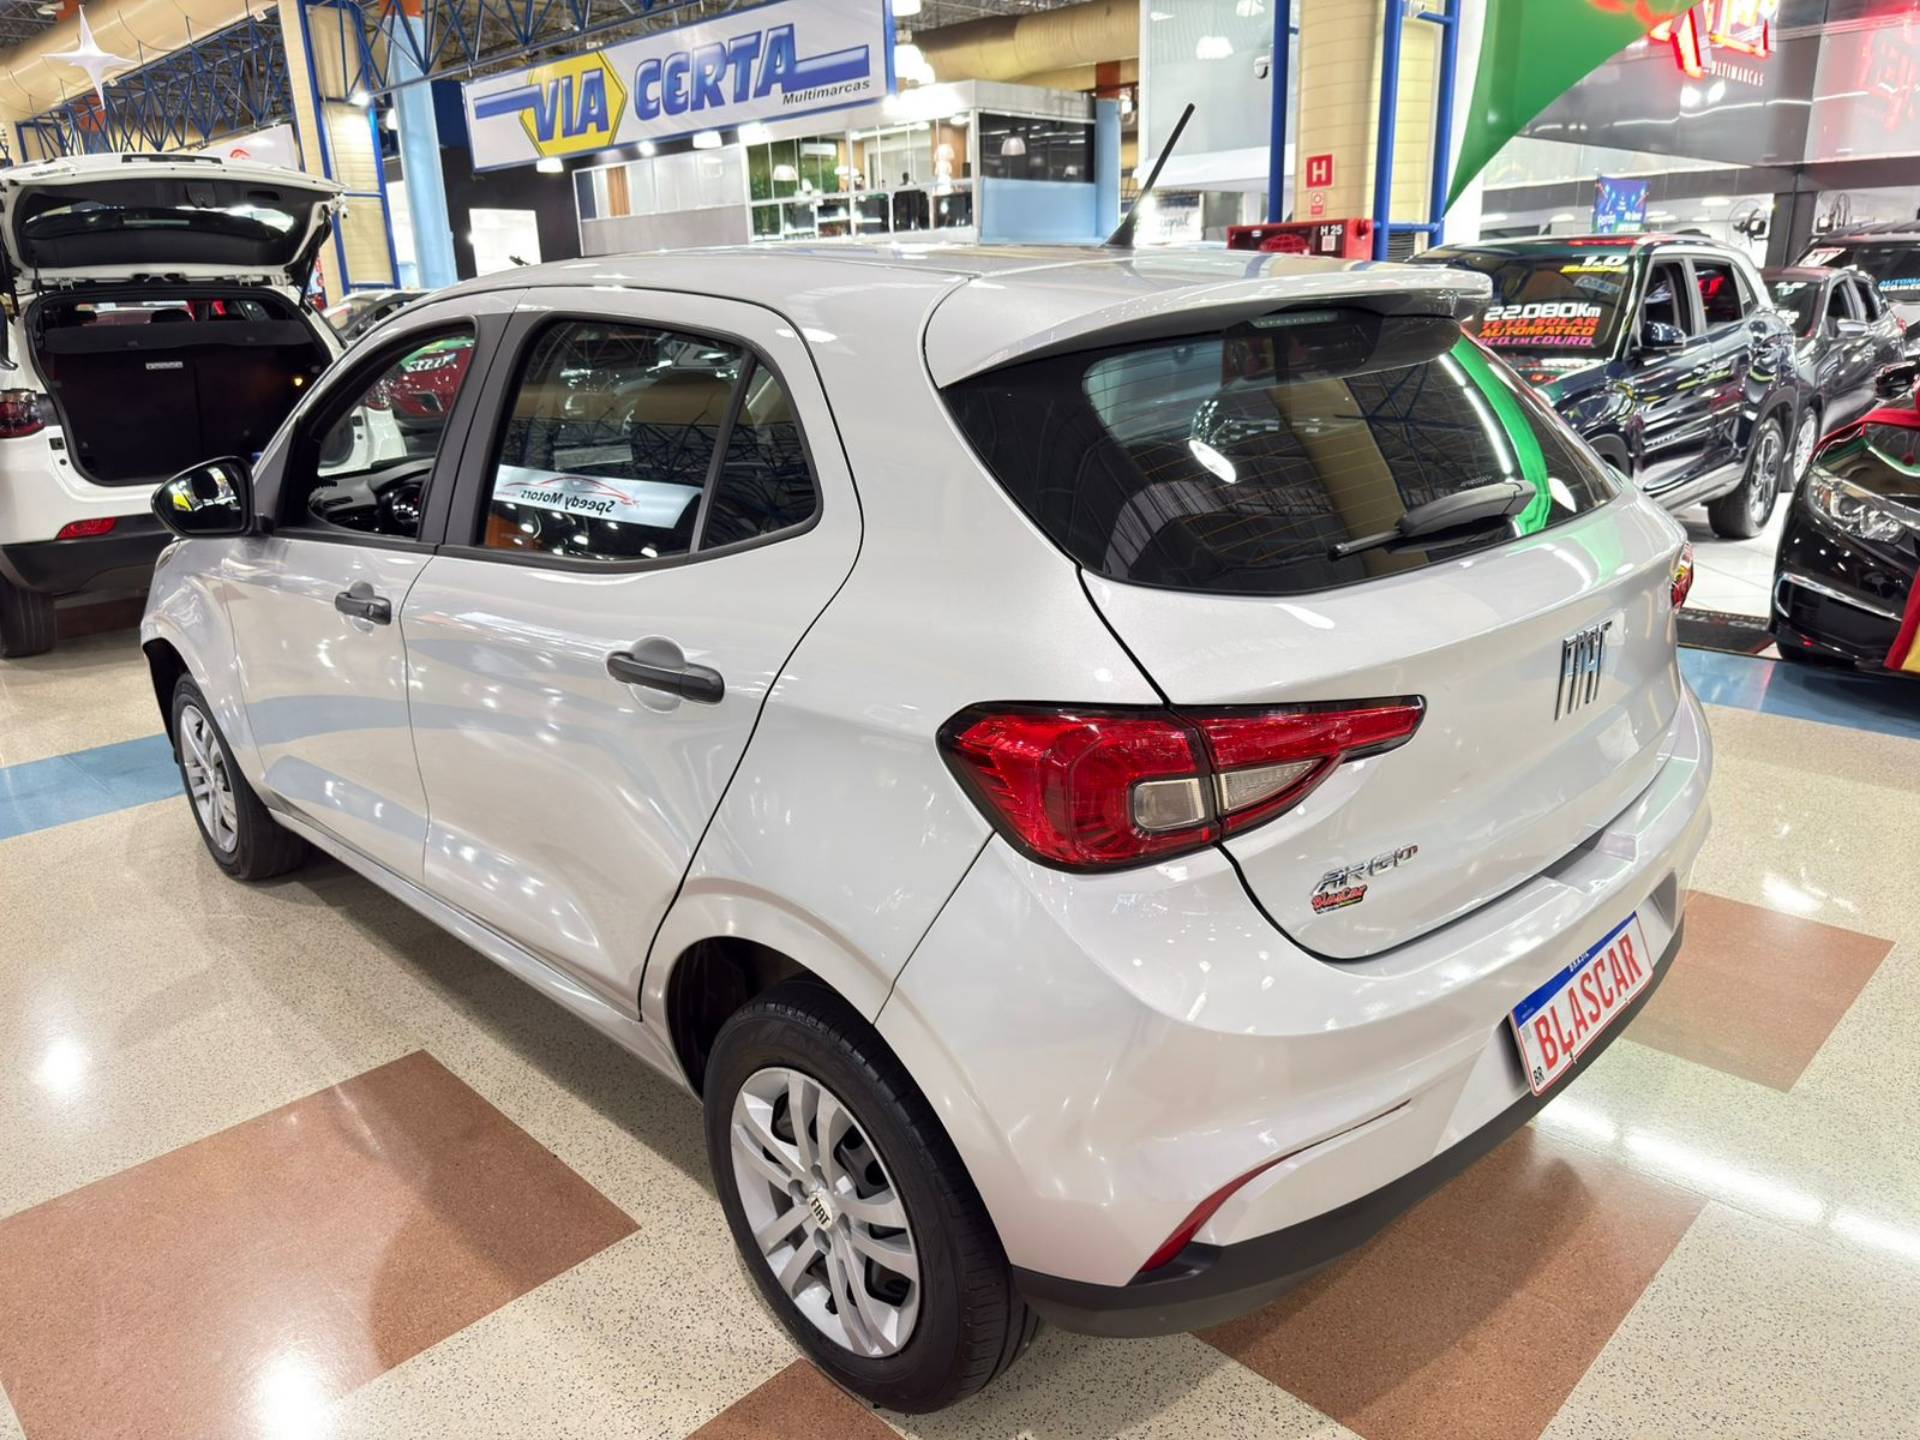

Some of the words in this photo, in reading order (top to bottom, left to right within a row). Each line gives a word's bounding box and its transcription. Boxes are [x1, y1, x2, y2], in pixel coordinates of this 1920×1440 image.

[534, 67, 610, 142] VIA
[634, 23, 799, 121] CERTA
[1704, 60, 1764, 87] ULTIMARCAS
[782, 79, 870, 105] Multimarcas
[1312, 160, 1327, 183] H
[1320, 226, 1328, 235] H
[1330, 224, 1343, 235] 25
[1583, 255, 1628, 266] 1.0
[1534, 317, 1600, 327] SOLAR
[1311, 844, 1419, 896] ARGO
[1534, 932, 1643, 1071] BLASCAR
[1533, 1065, 1545, 1086] BR
[811, 1197, 831, 1225] FIAT
